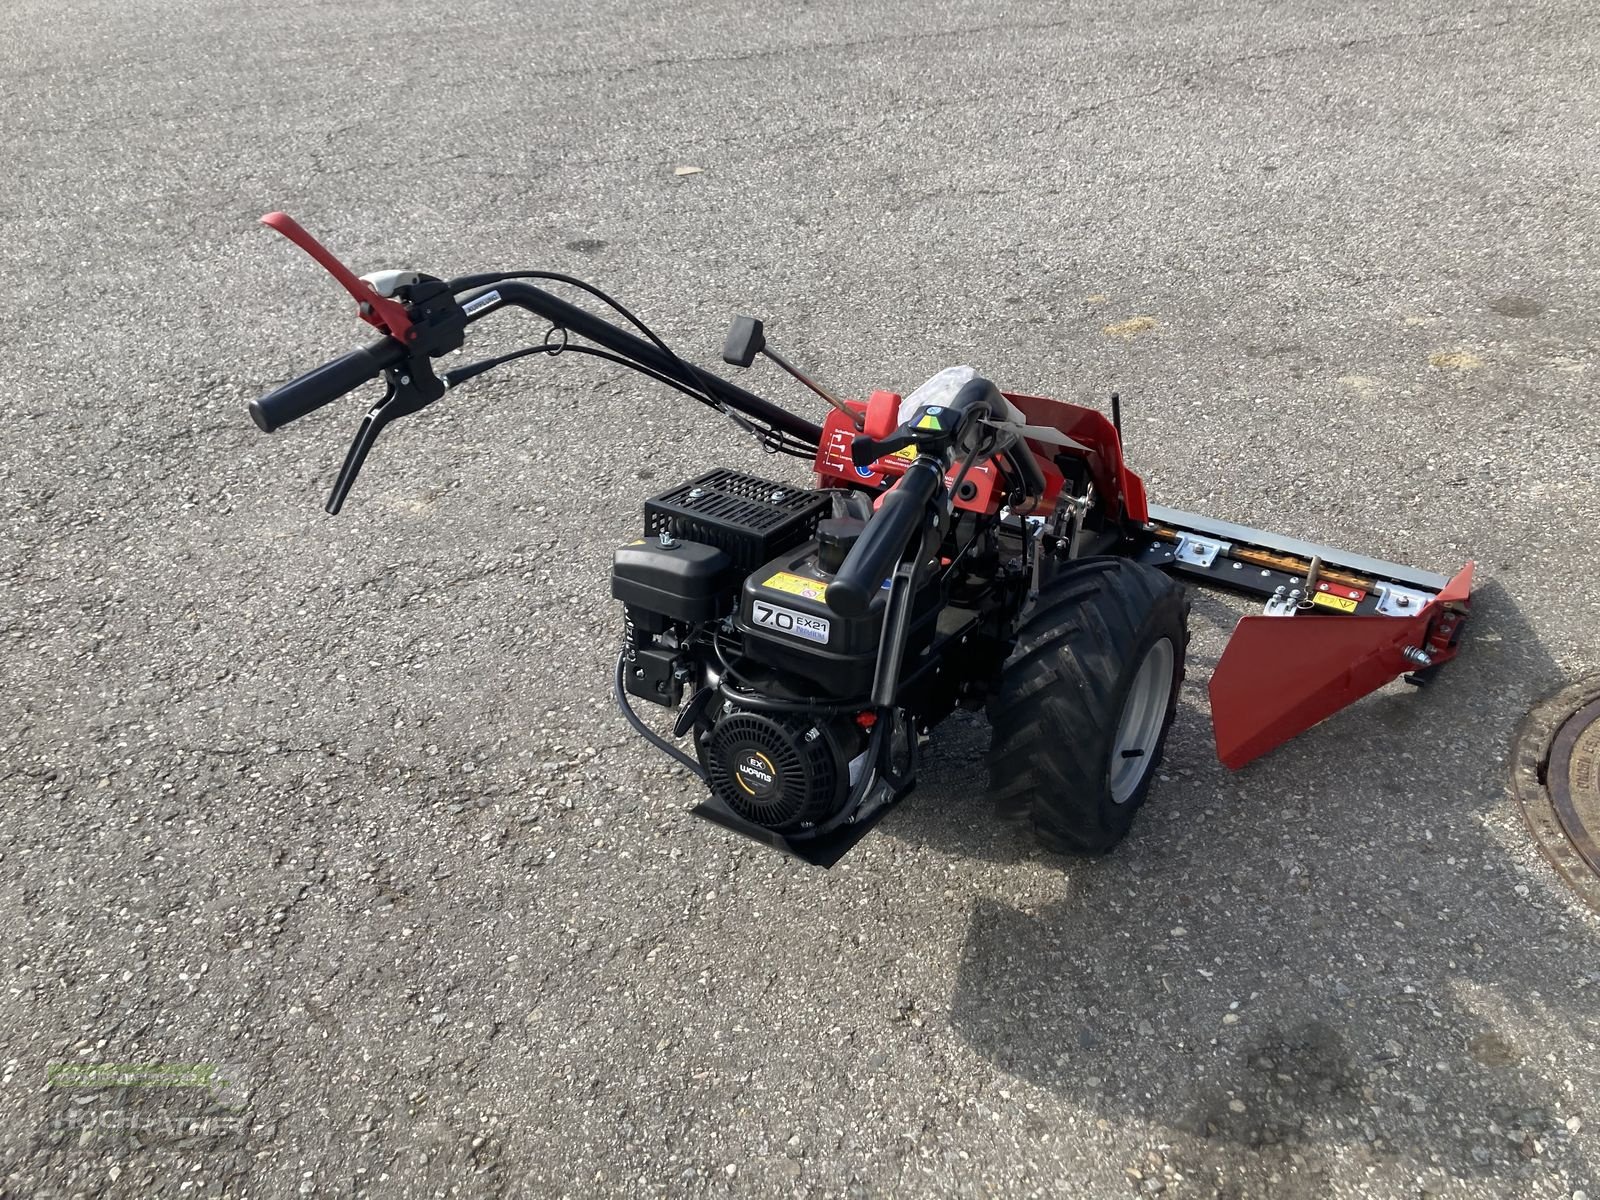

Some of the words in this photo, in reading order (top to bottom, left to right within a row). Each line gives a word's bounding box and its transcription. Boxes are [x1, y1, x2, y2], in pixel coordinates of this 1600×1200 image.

[757, 605, 794, 631] 7.0
[796, 616, 827, 632] EX21
[750, 758, 764, 769] EX
